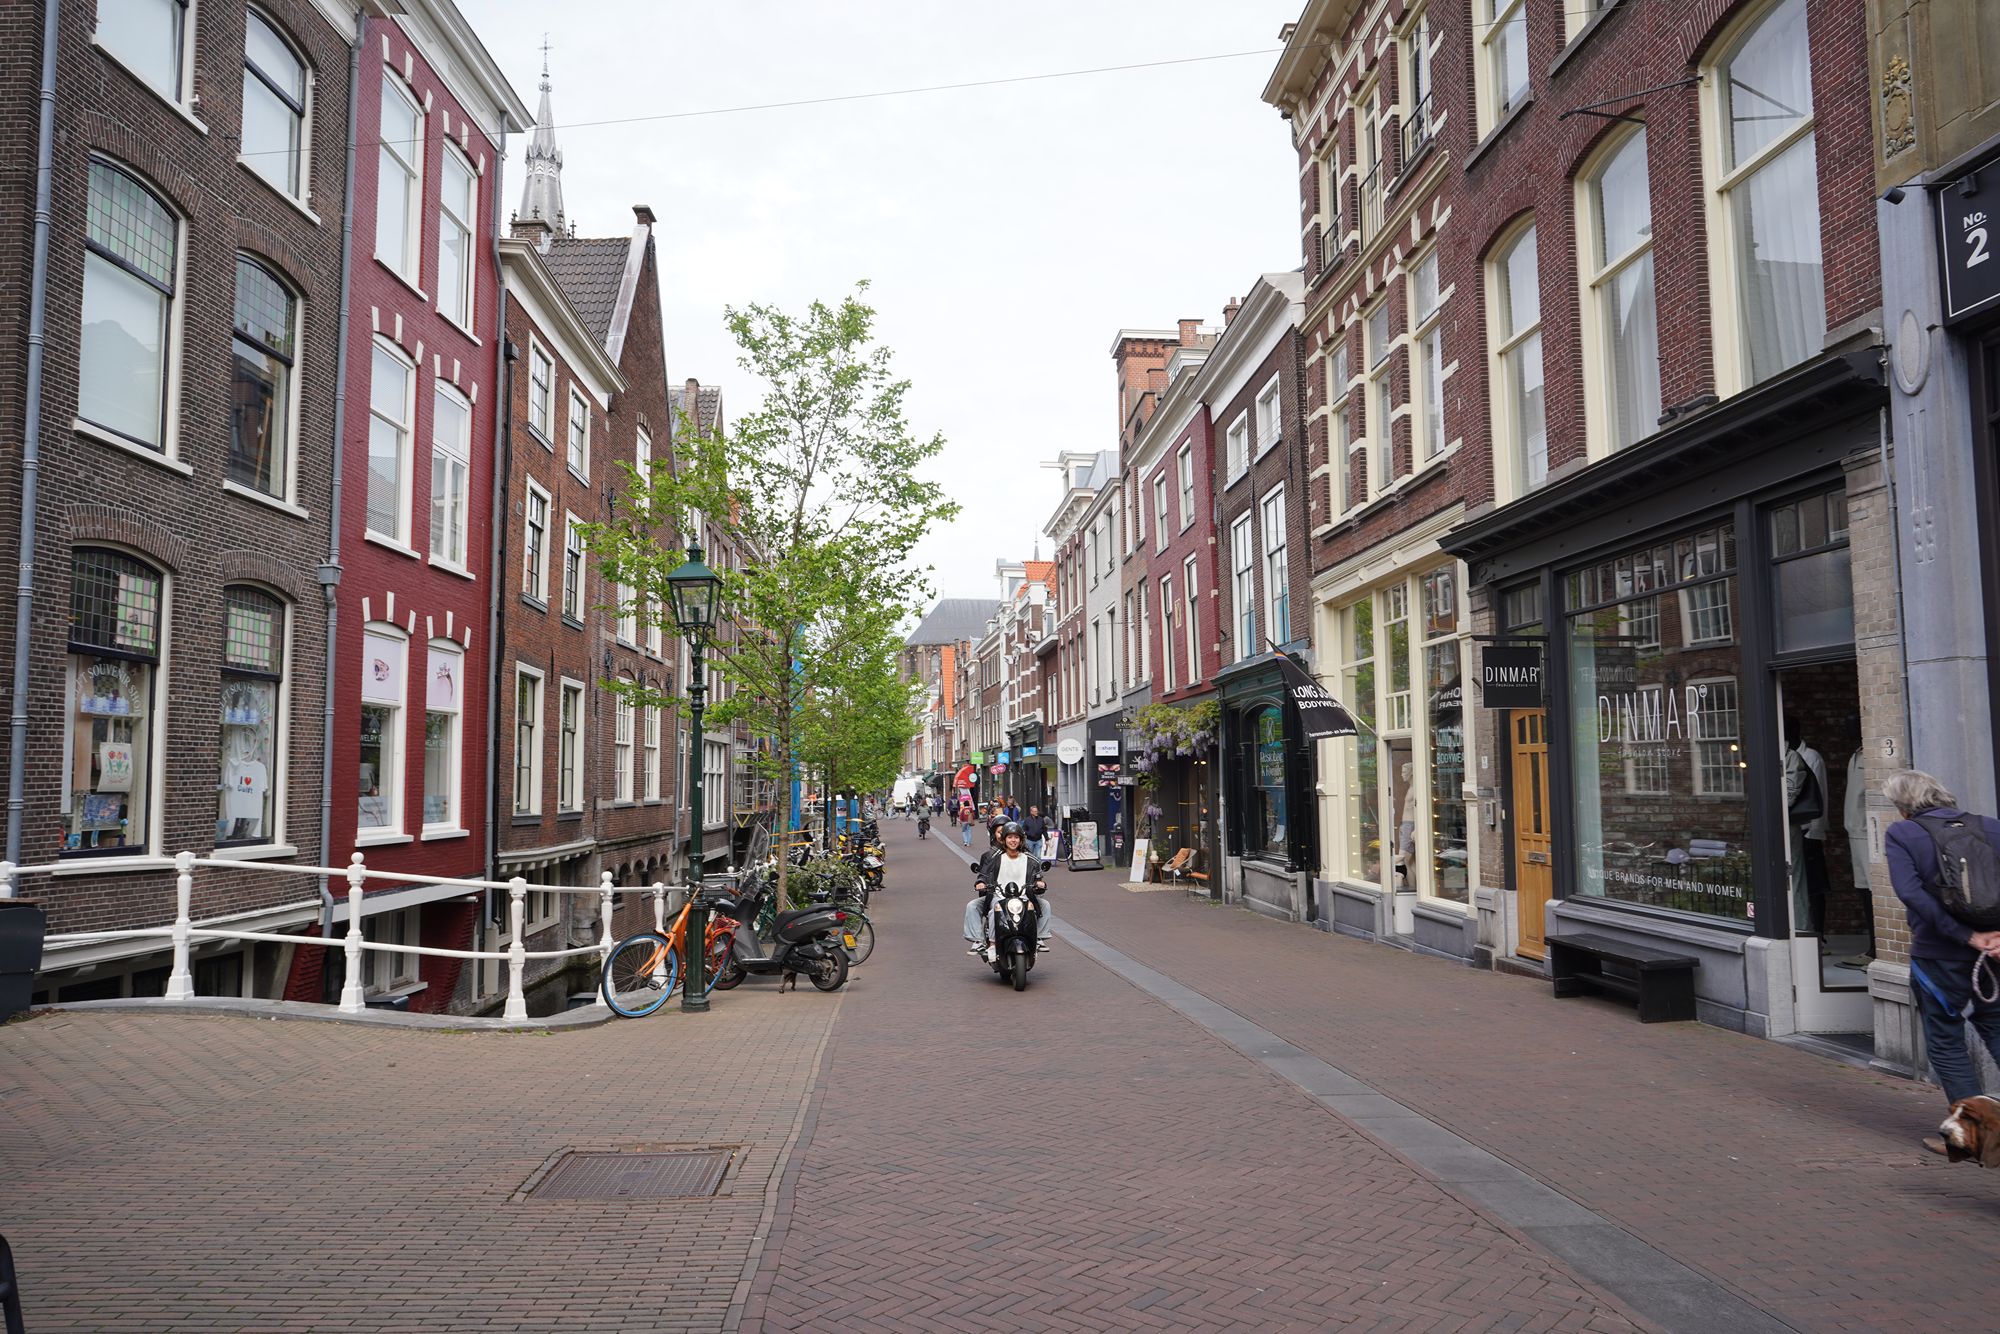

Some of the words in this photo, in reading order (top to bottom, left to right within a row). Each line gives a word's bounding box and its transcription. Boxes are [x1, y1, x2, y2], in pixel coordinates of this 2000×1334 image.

[1963, 212, 1987, 228] No.
[1965, 227, 1990, 269] 2
[88, 664, 131, 687] SOUVENIR
[1485, 666, 1537, 682] DINMAR
[1293, 685, 1318, 698] LONG
[1599, 686, 1700, 742] DINMAR
[1885, 739, 1894, 756] 3
[1615, 871, 1645, 885] BRANDS
[1647, 876, 1663, 887] FOR
[1665, 879, 1683, 890] MEN
[1686, 881, 1704, 893] AND
[1706, 884, 1742, 899] WOMEN
